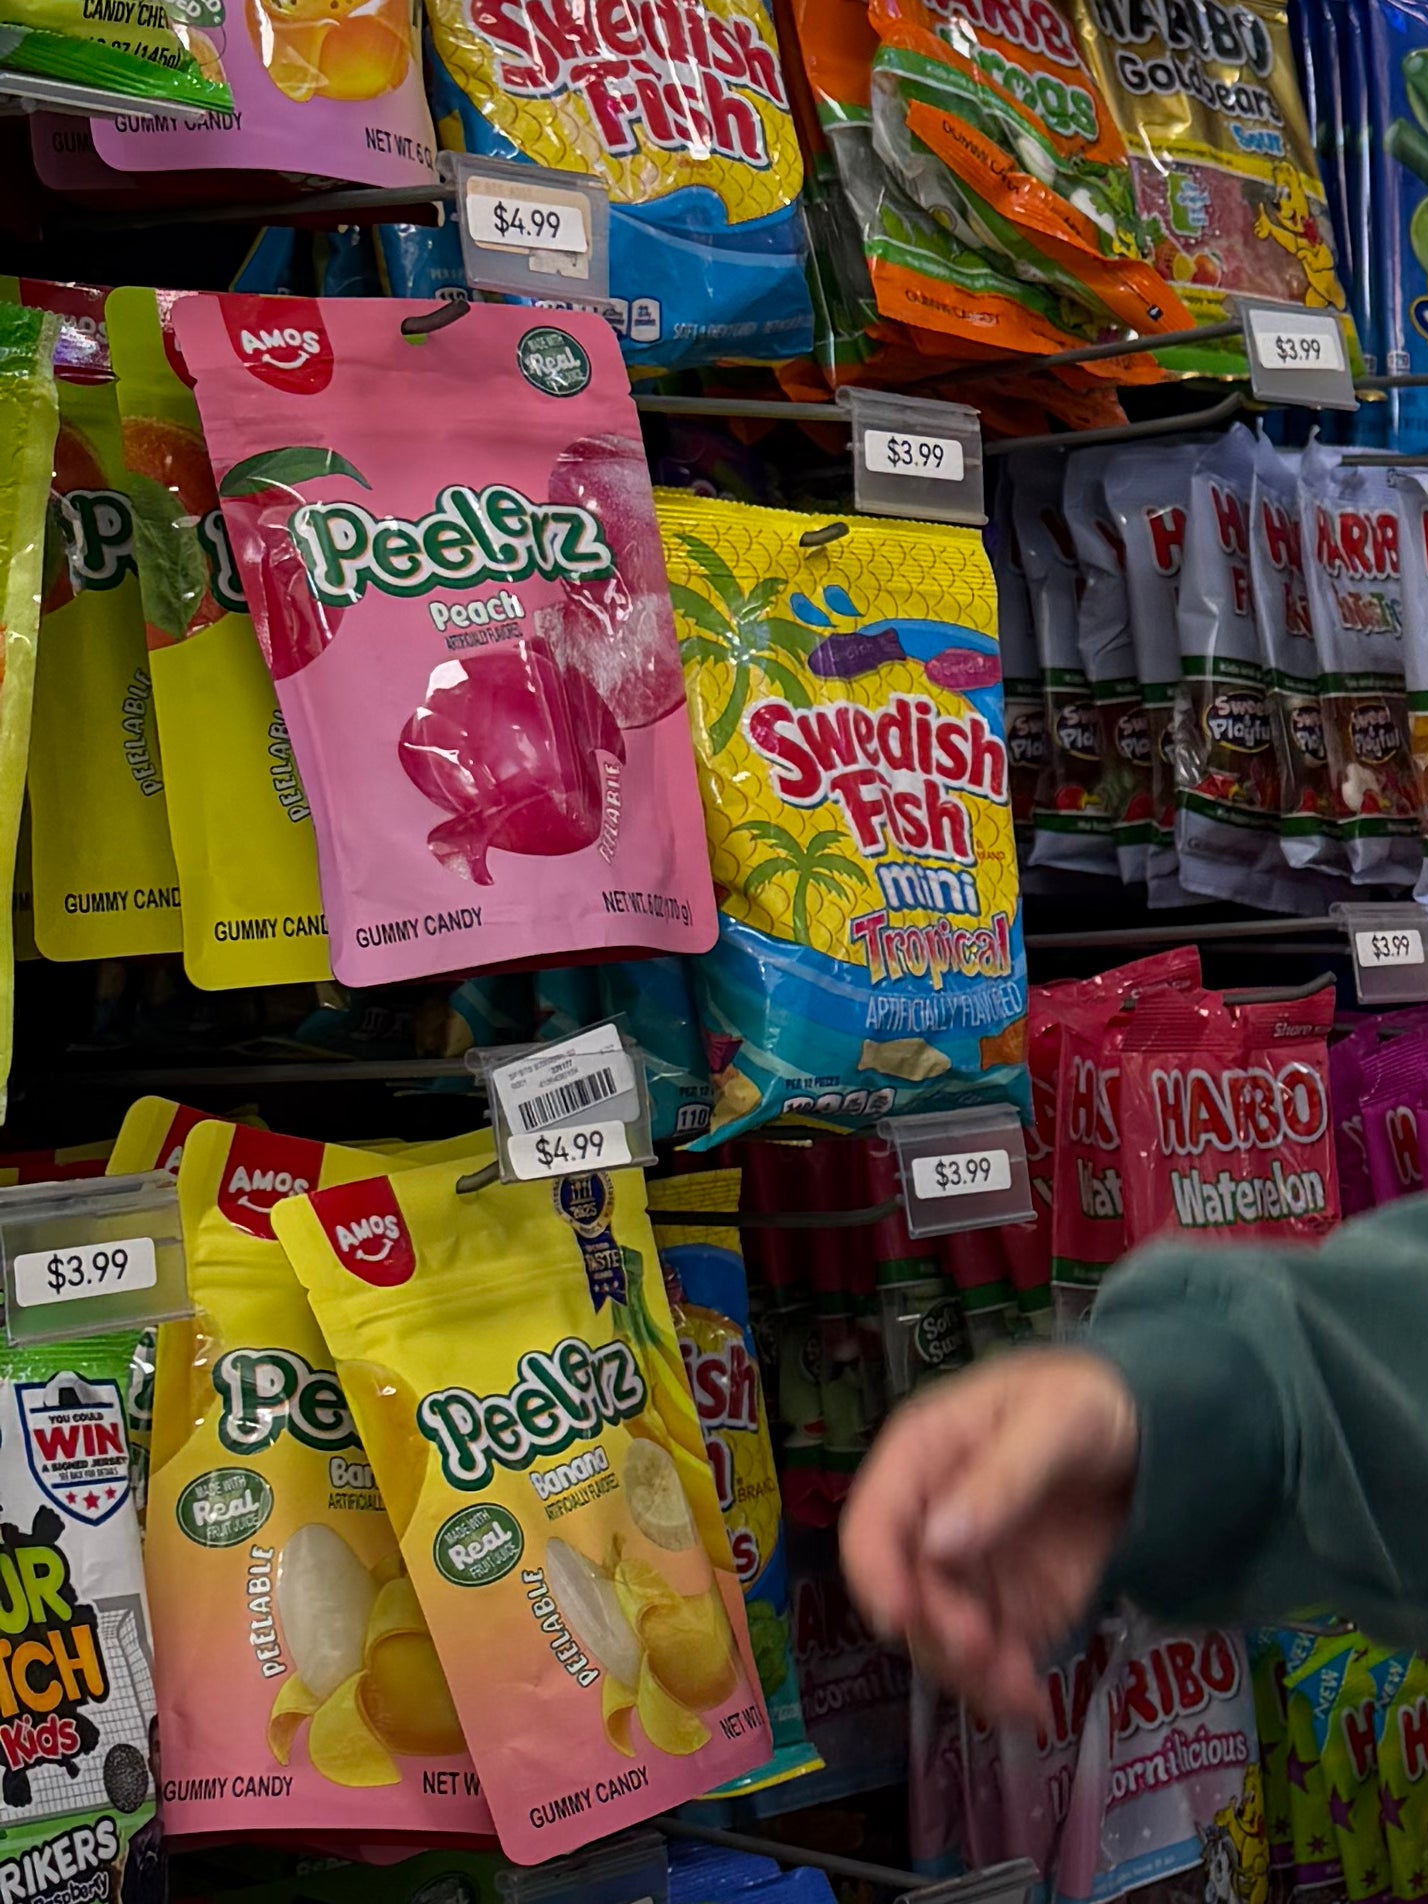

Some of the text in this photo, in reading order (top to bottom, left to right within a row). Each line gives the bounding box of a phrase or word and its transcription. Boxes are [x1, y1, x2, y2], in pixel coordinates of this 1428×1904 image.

[570, 59, 771, 166] Fish
[365, 126, 391, 153] NET
[493, 203, 561, 238] $4.99
[241, 328, 320, 356] AMOS
[1275, 336, 1321, 363] $3.99
[525, 349, 582, 376] Real
[887, 439, 945, 472] $3.99
[287, 484, 617, 608] Peelerz
[429, 590, 525, 632] Peach
[121, 665, 166, 799] PEELABLE
[744, 696, 1009, 808] Swedish
[830, 768, 974, 865] Fish
[64, 890, 128, 914] GUMMY
[602, 890, 628, 913] NET
[876, 860, 980, 918] mini
[213, 916, 280, 943] GUMMY
[356, 906, 483, 948] GUMMY CANDY
[850, 912, 1012, 994] Tropical
[1372, 934, 1411, 961] $3.99
[679, 1108, 708, 1129] 110
[535, 1129, 605, 1170] $4.99
[228, 1164, 311, 1198] AMOS
[934, 1157, 992, 1189] $3.99
[337, 1214, 399, 1249] AMOS
[46, 1247, 131, 1293] $3.99
[49, 1411, 104, 1425] YOU COULD
[416, 1336, 647, 1492] Peelerz
[33, 1422, 125, 1462] WIN
[194, 1474, 246, 1499] MADE WITH
[529, 1446, 610, 1502] Banana
[192, 1498, 260, 1526] Real
[206, 1515, 261, 1541] FRUIT JUICE
[444, 1508, 493, 1547] MADE WITH
[447, 1523, 513, 1570] Real
[469, 1543, 518, 1580] FRUIT JUICE
[247, 1545, 288, 1679] PEELABLE
[520, 1567, 601, 1689] PEELABLE
[1313, 1668, 1341, 1718] NEW
[0, 1712, 80, 1772] Kids
[163, 1772, 293, 1804] GUMMY CANDY
[422, 1770, 457, 1796] NET
[529, 1765, 651, 1831] GUMMY CANDY
